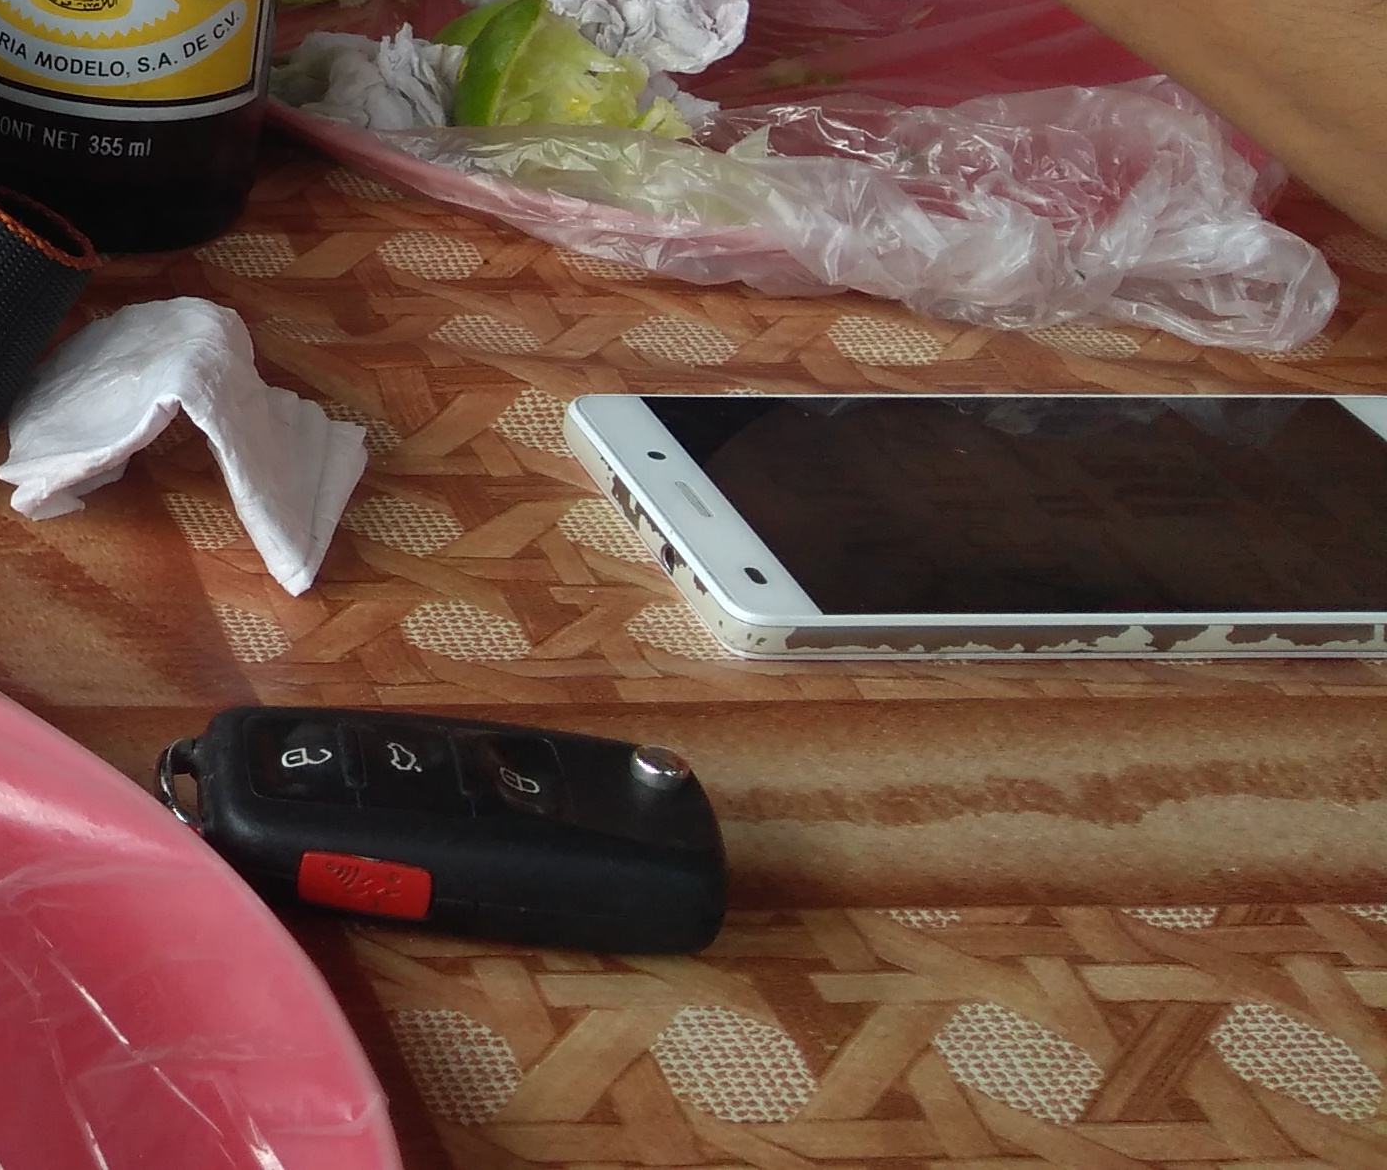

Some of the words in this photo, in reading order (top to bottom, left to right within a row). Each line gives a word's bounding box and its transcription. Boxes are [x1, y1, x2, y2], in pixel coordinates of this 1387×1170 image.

[137, 52, 178, 73] S.A.
[182, 33, 209, 58] DE
[212, 10, 240, 39] C.V.
[88, 135, 123, 157] 355
[128, 138, 152, 157] ml
